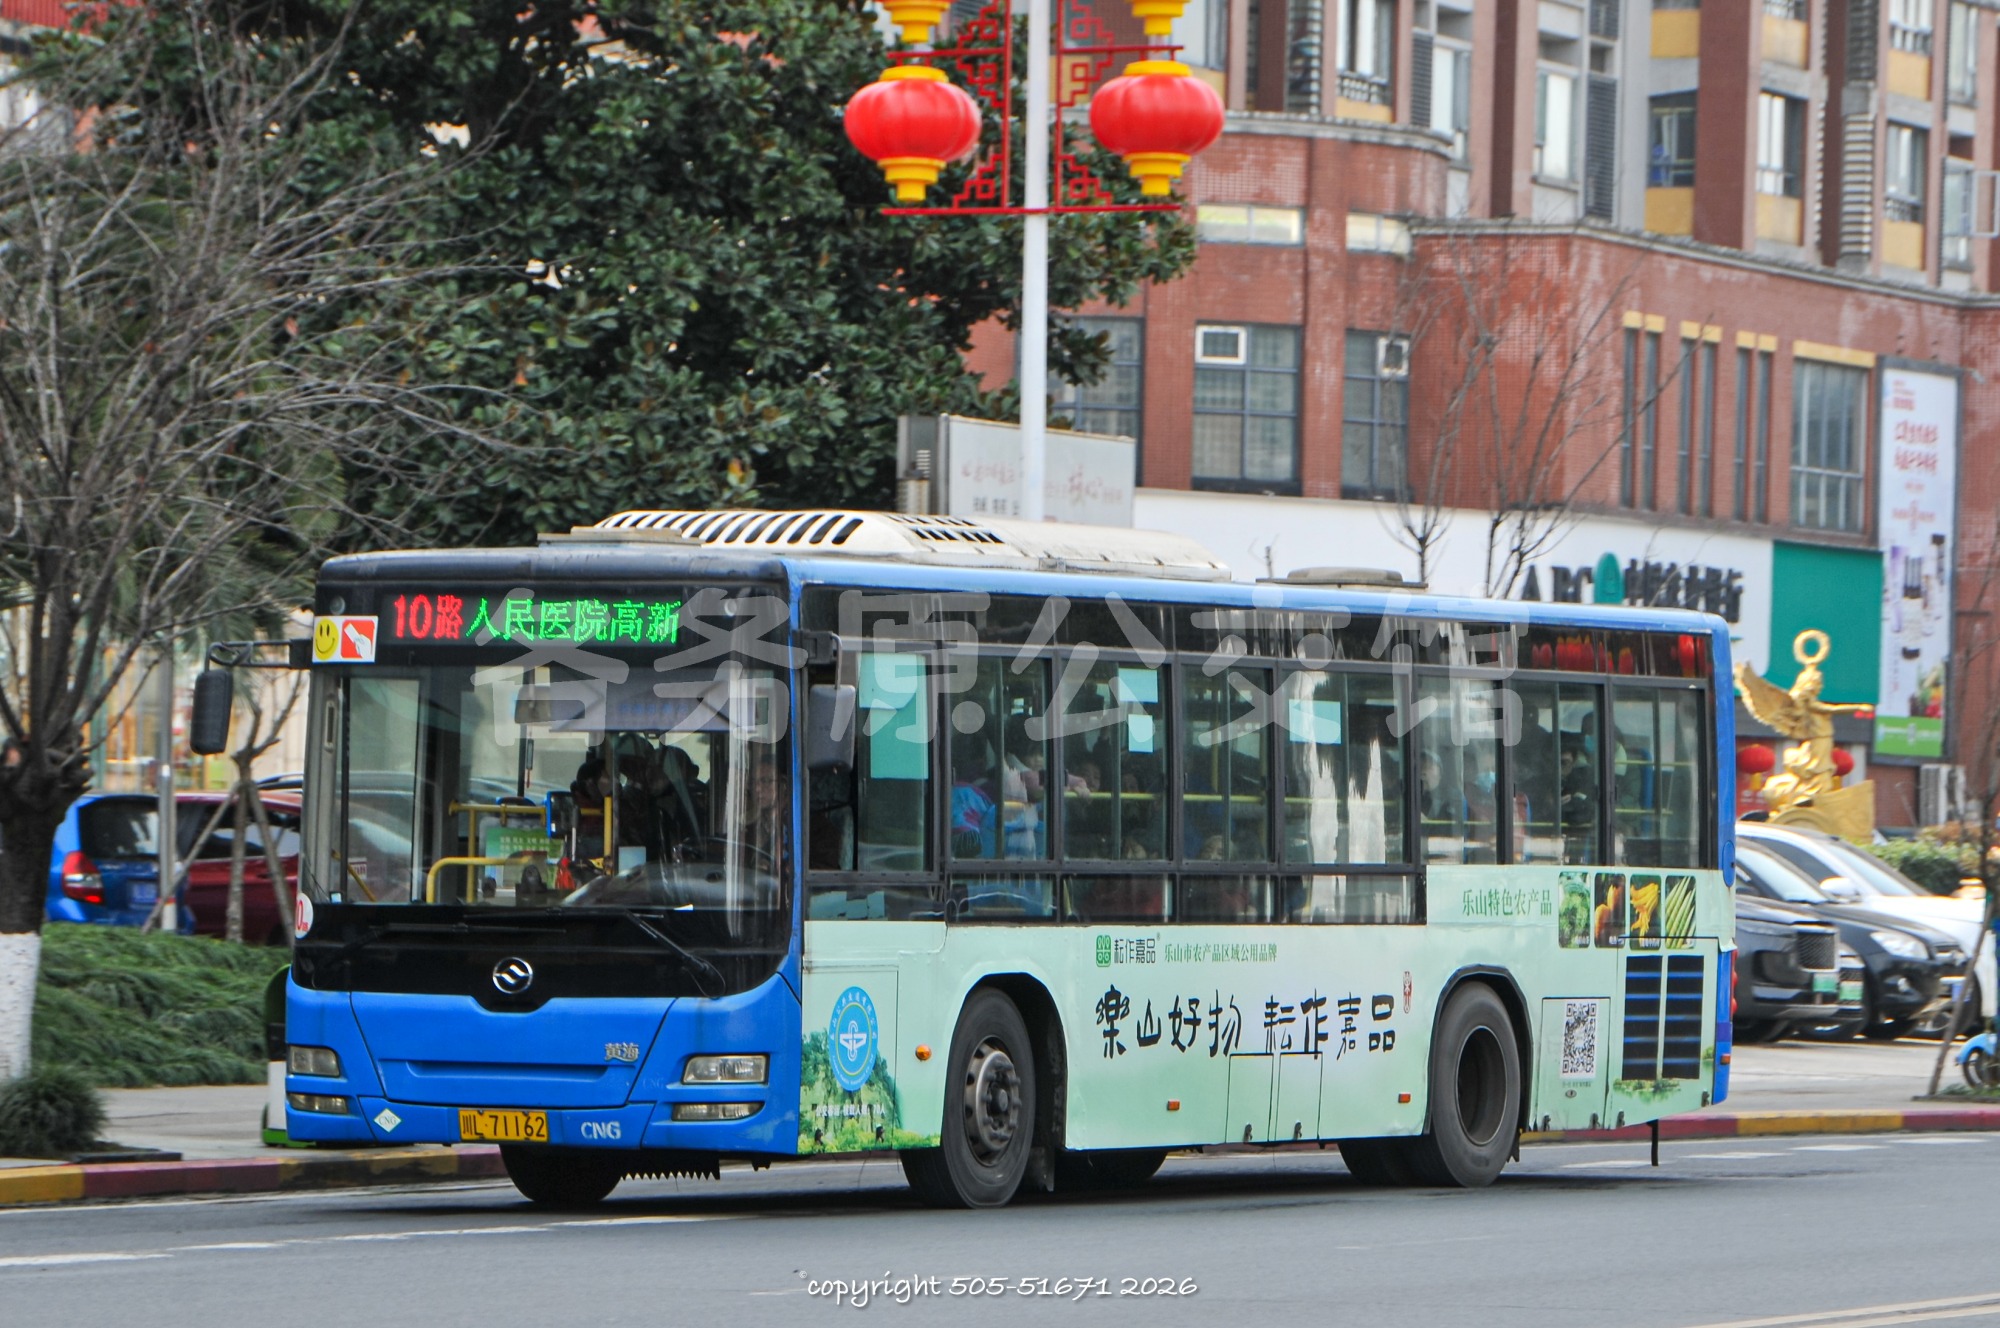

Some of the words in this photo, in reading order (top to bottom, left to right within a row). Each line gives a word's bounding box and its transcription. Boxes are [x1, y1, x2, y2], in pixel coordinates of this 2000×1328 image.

[394, 594, 464, 639] 10路
[465, 597, 682, 644] 人民医院高新
[1462, 888, 1552, 917] 乐山特色农产品
[1113, 938, 1156, 964] 耘作嘉品
[1164, 943, 1278, 963] 乐山市农产品区域公用品牌
[1263, 988, 1396, 1061] 耘作嘉品
[604, 1042, 639, 1062] 黄海
[580, 1121, 622, 1139] CNG
